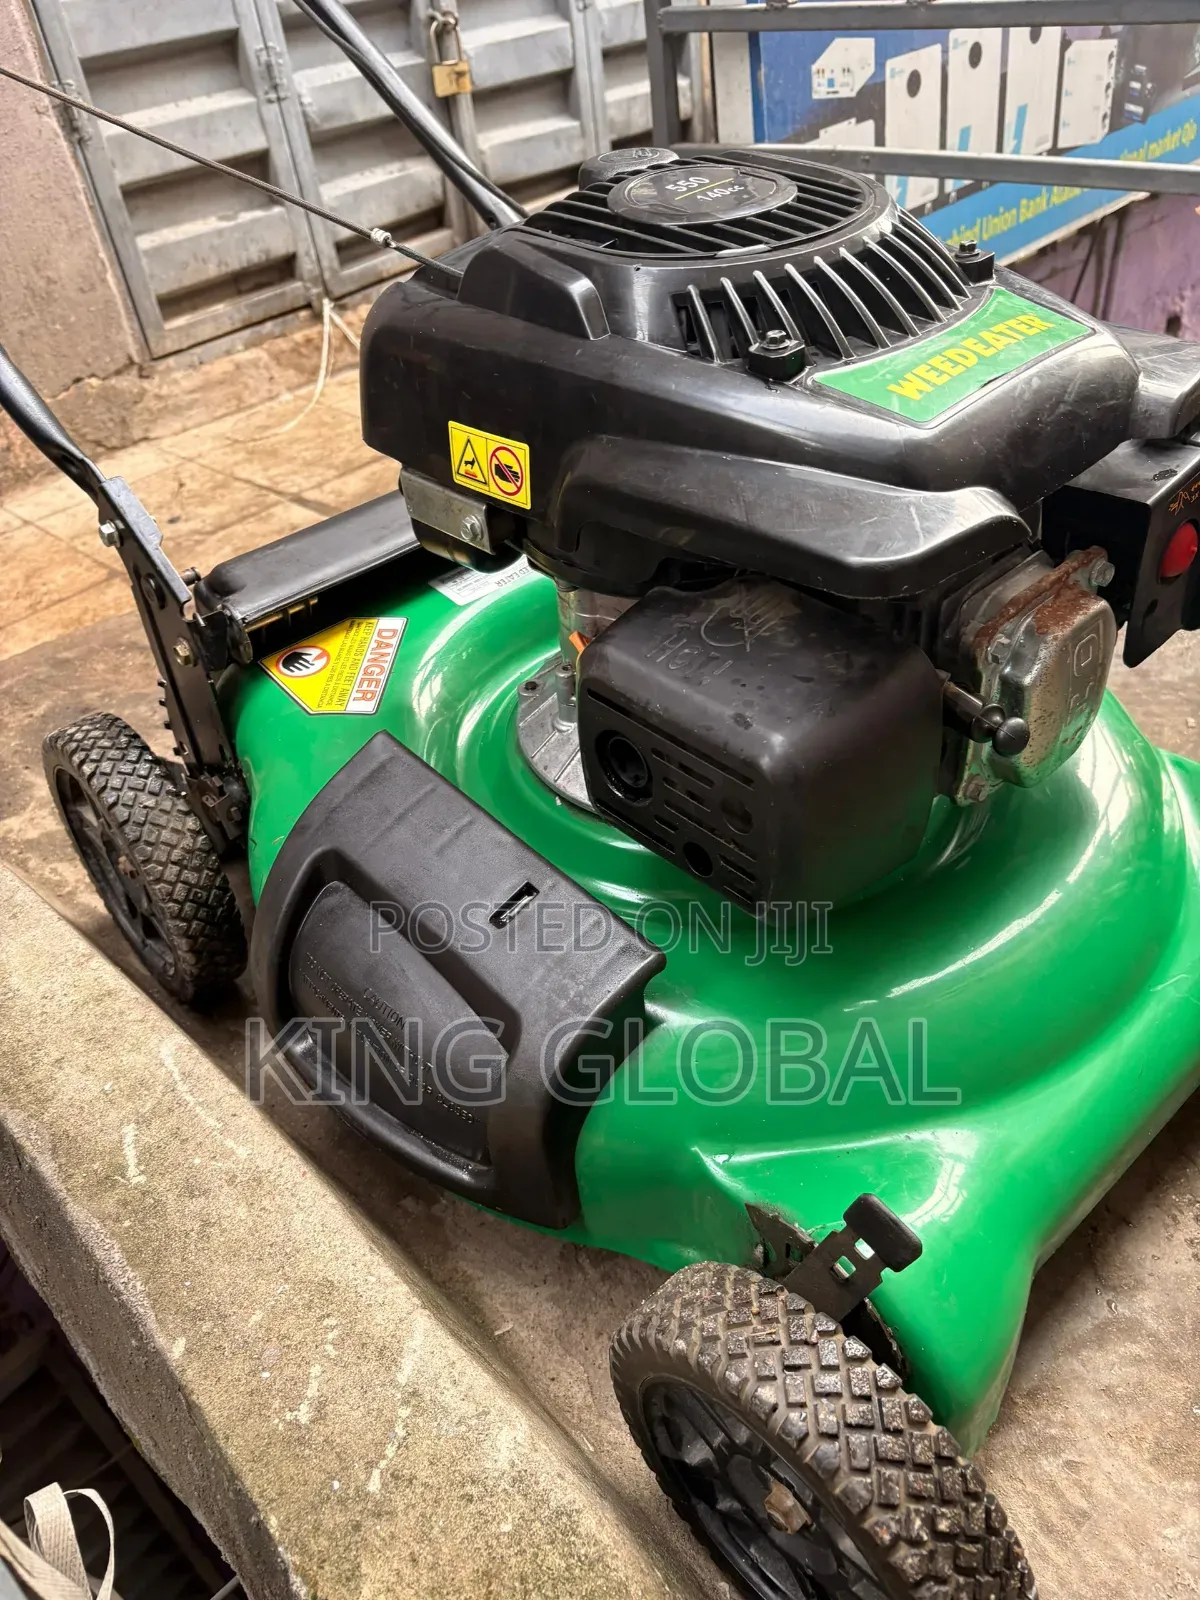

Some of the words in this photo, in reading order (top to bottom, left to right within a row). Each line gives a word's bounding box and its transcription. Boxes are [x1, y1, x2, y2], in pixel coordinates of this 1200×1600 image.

[665, 176, 710, 192] 550
[696, 184, 745, 202] 140cc
[982, 206, 1017, 241] Union
[1019, 185, 1049, 224] Bank
[362, 622, 373, 635] KEEP
[353, 637, 367, 655] HANDS
[348, 657, 359, 669] AND
[352, 627, 399, 703] DANGER
[342, 672, 355, 686] FEET
[334, 687, 348, 706] AWAY
[362, 986, 408, 1031] CAUTION
